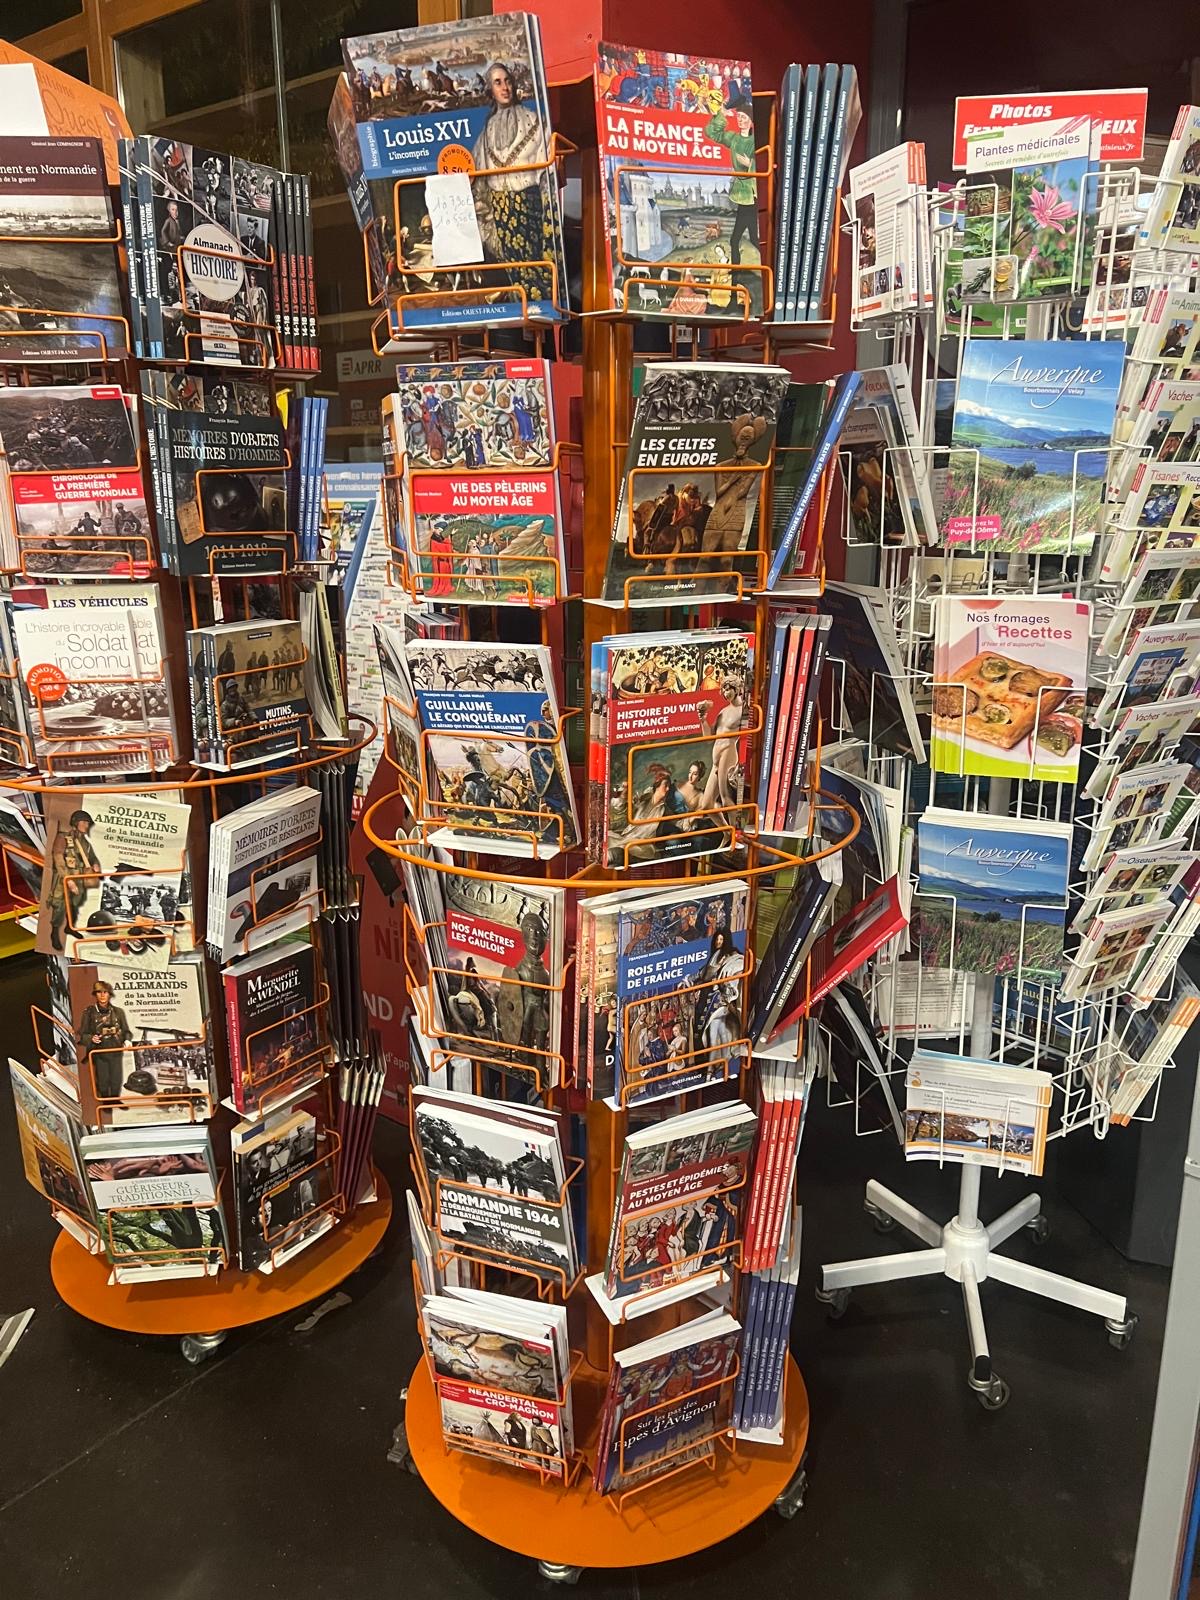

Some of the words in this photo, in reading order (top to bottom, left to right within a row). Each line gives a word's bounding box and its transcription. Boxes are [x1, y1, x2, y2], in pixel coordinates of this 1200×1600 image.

[989, 103, 1053, 120] Photos
[383, 123, 434, 148] Louis
[437, 118, 472, 139] XVI
[607, 116, 629, 134] LA
[634, 119, 704, 142] FRANCE
[388, 148, 430, 161] L'incompris
[607, 134, 629, 150] AU
[633, 137, 688, 156] MOYEN
[692, 141, 722, 159] ÂGE
[975, 146, 1014, 158] Plantes
[1016, 134, 1081, 152] médicinales
[441, 148, 472, 164] PROMOTION
[25, 166, 38, 174] en
[40, 164, 97, 175] Normandie
[193, 237, 233, 253] Almanach
[127, 247, 137, 298] Almanach
[191, 253, 238, 281] HISTOIRE
[441, 309, 462, 318] Editions
[462, 306, 507, 317] OUEST-FRANCE
[354, 359, 382, 375] APRR
[990, 354, 1105, 409] Auvergne
[1023, 387, 1060, 395] Bourbonnais
[1068, 388, 1085, 396] Velay
[1168, 389, 1194, 401] Vaches
[172, 426, 228, 444] MÉMOIRES
[230, 431, 280, 447] D'OBJETS
[640, 438, 666, 451] LES
[668, 437, 716, 451] CELTES
[173, 445, 227, 460] HISTOIRES
[229, 448, 281, 462] D'HOMMES
[637, 454, 659, 467] EN
[661, 452, 718, 467] EUROPE
[818, 441, 831, 462] DATES
[810, 472, 819, 483] EN
[1150, 469, 1180, 482] Tisanes
[53, 483, 66, 491] LA
[67, 480, 111, 490] PREMIÈRE
[55, 491, 91, 500] GUERRE
[91, 488, 138, 498] MONDIALE
[450, 482, 475, 493] VIE
[476, 482, 492, 492] DES
[494, 479, 547, 493] PÈLERINS
[452, 495, 468, 506] AU
[472, 495, 508, 506] MOYEN
[510, 493, 533, 506] ÂGE
[800, 482, 814, 507] FRANCE
[796, 506, 805, 516] DE
[783, 516, 801, 548] L'HISTOIRE
[53, 599, 76, 609] LES
[78, 595, 149, 608] VÉHICULES
[25, 622, 70, 634] L'histoire
[73, 621, 126, 635] incroyable
[966, 613, 990, 623] Nos
[993, 613, 1050, 626] fromages
[998, 625, 1073, 640] Recettes
[67, 633, 129, 653] Soldat
[1006, 641, 1046, 649] d'aujourd'hui
[55, 653, 131, 671] inconnu
[265, 705, 292, 719] MUTINS
[425, 700, 493, 712] GUILLAUME
[616, 707, 662, 720] HISTOIRE
[663, 706, 677, 716] DU
[678, 703, 697, 714] VIN
[429, 711, 443, 722] LE
[444, 711, 527, 725] CONQUÉRANT
[616, 720, 631, 731] EN
[632, 716, 669, 729] FRANCE
[1136, 712, 1160, 722] Vaches
[624, 729, 656, 739] L'ANTIQUITÉ
[655, 727, 661, 735] À
[667, 723, 700, 733] RÉVOLUTION
[108, 805, 167, 822] SOLDATS
[95, 812, 178, 834] AMÉRICAINS
[234, 823, 279, 852] MÉMOIRES
[279, 806, 317, 832] D'OBJETS
[106, 826, 117, 834] de
[119, 828, 128, 836] la
[129, 829, 164, 841] bataille
[116, 834, 165, 849] Normandie
[233, 841, 268, 865] HISTOIRES
[268, 837, 278, 846] DE
[278, 820, 316, 842] RÉSISTANTS
[946, 838, 1053, 876] Auvergne
[1127, 857, 1158, 865] Oiseaux
[451, 922, 470, 934] NOS
[471, 928, 515, 948] ANCÊTRES
[451, 932, 467, 943] LES
[468, 937, 506, 955] GAULOIS
[627, 964, 654, 978] ROIS
[655, 961, 668, 972] ET
[670, 950, 708, 968] REINES
[122, 971, 176, 981] SOLDATS
[247, 968, 299, 995] Marguerite
[627, 979, 642, 990] DE
[643, 968, 684, 986] FRANCE
[113, 981, 188, 991] ALLEMANDS
[247, 995, 257, 1006] de
[257, 976, 301, 1002] WENDEL
[116, 1181, 191, 1195] GUÉRISSEURS
[629, 1183, 667, 1200] PESTES
[666, 1179, 678, 1189] ET
[678, 1163, 730, 1185] ÉPIDÉMIES
[110, 1188, 201, 1204] TRADITIONNELS
[627, 1199, 643, 1210] AU
[644, 1188, 681, 1206] MOYEN
[683, 1179, 703, 1193] ÂGE
[440, 1189, 523, 1219] NORMANDIE
[524, 1209, 561, 1229] 1944
[447, 1202, 502, 1220] DÉBARQUEMENT
[449, 1209, 459, 1217] LA
[459, 1212, 490, 1224] BATAILLE
[500, 1221, 542, 1237] NORMANDIE
[468, 1387, 538, 1409] NEANDERTAL
[484, 1398, 554, 1420] CRO-MAGNON
[637, 1420, 653, 1431] Sur
[654, 1414, 666, 1424] les
[666, 1408, 682, 1423] pas
[683, 1400, 698, 1411] des
[651, 1400, 717, 1435] d'Avignon
